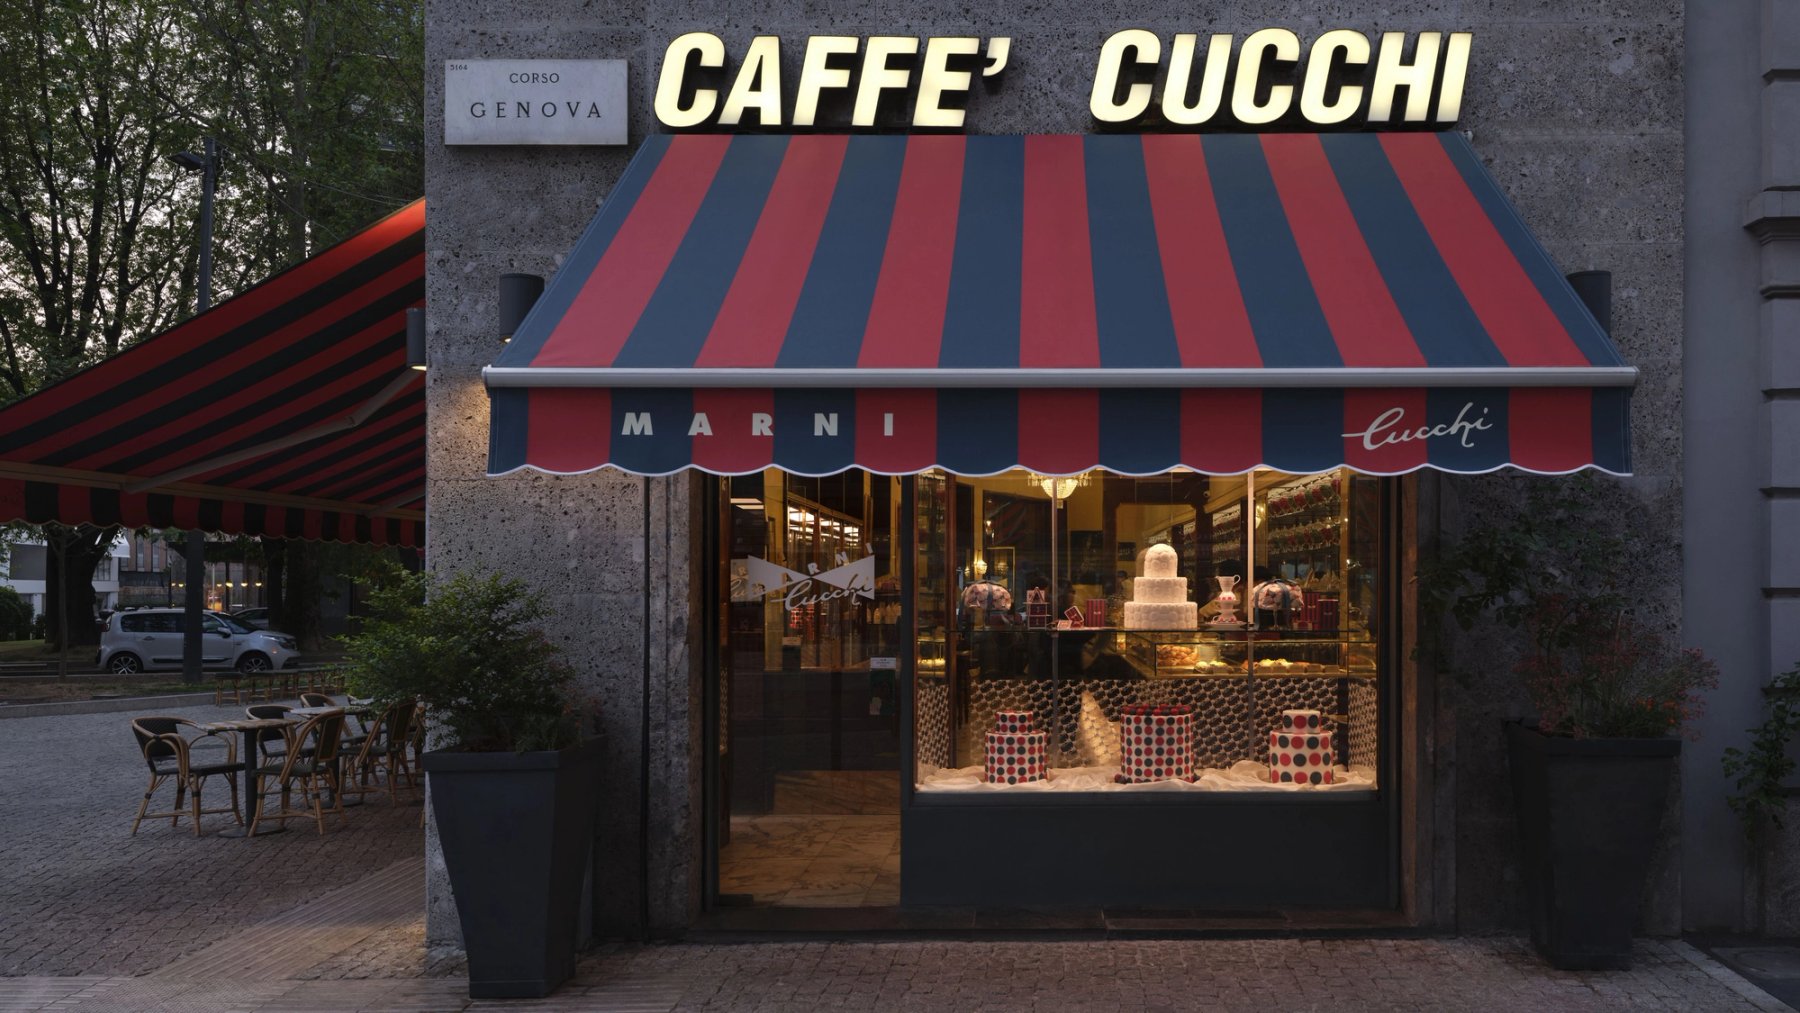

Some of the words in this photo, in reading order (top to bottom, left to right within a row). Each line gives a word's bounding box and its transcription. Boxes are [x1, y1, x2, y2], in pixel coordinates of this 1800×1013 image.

[509, 72, 560, 84] CORSO
[1089, 28, 1473, 125] CUCCHI
[470, 102, 602, 118] GENOVA
[621, 412, 894, 437] MARNI
[1341, 402, 1494, 451] Cucchi
[769, 573, 873, 611] Cucchi
